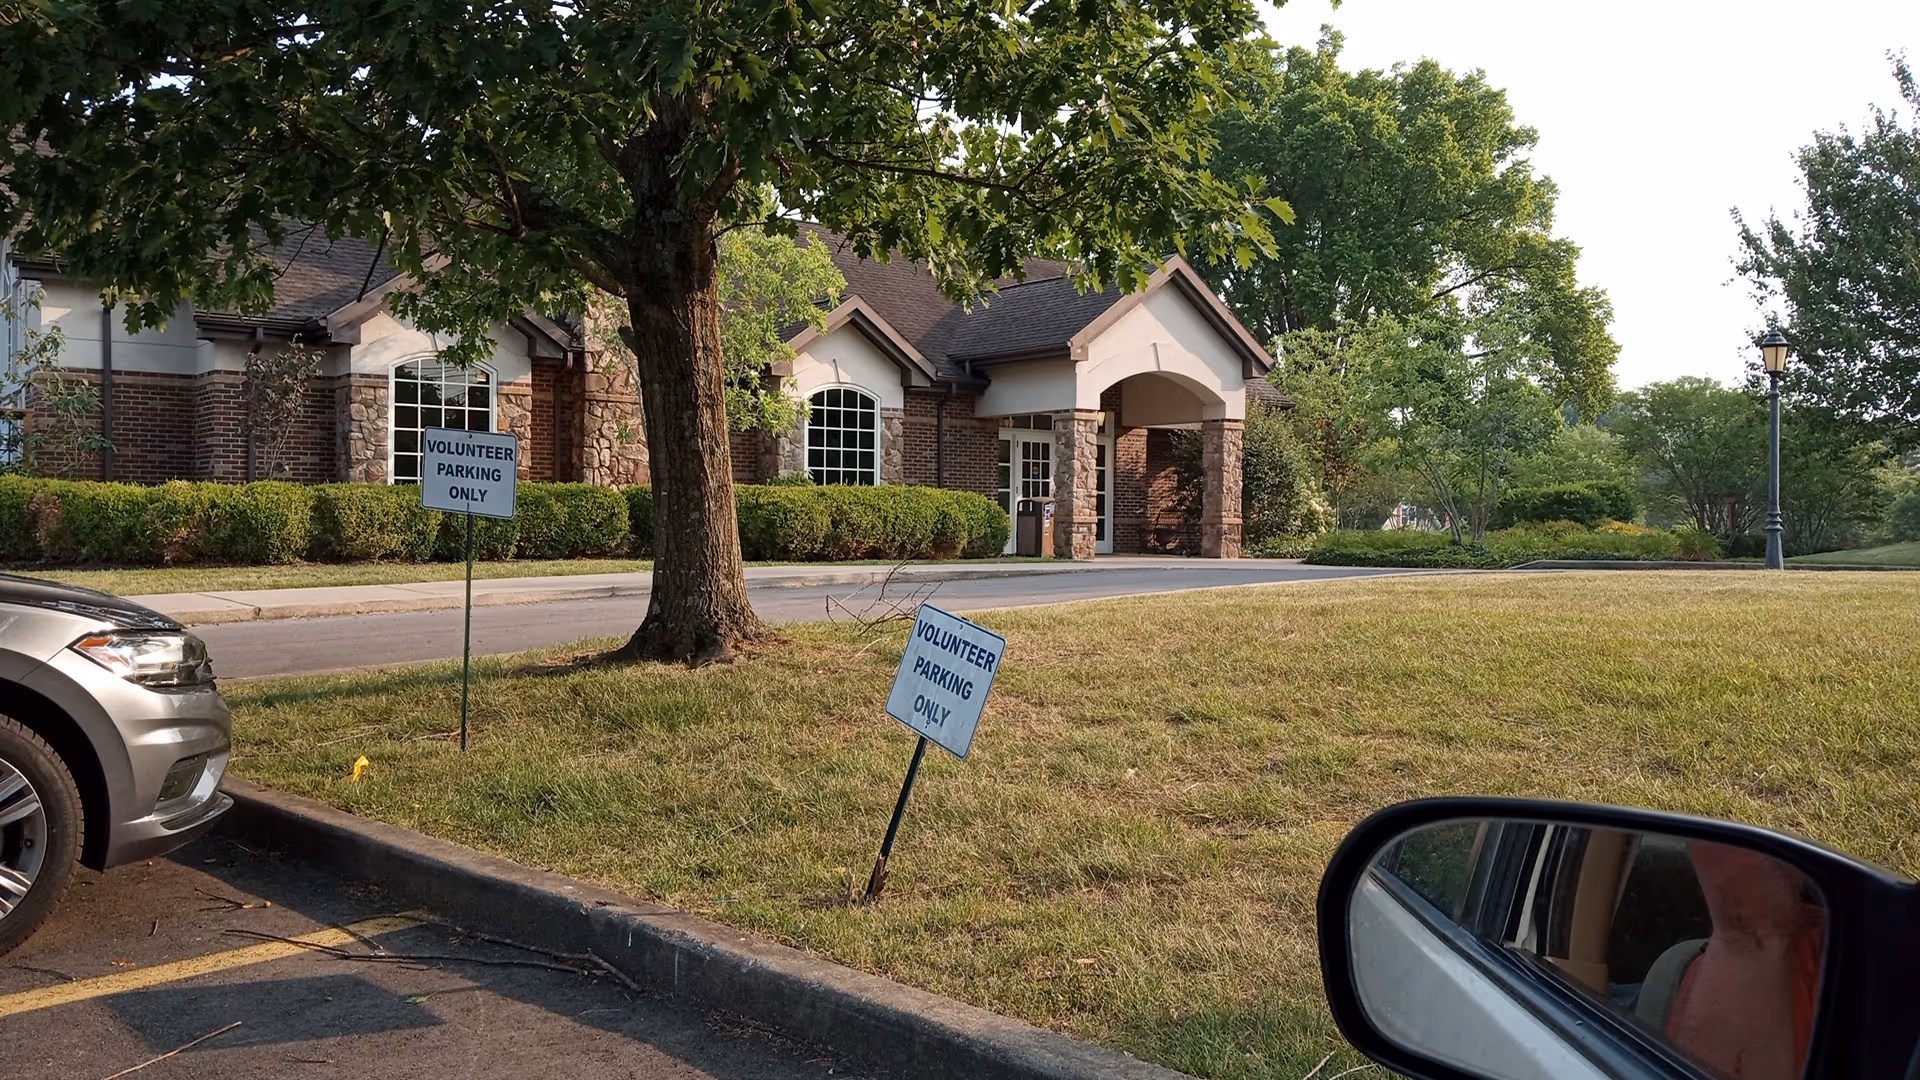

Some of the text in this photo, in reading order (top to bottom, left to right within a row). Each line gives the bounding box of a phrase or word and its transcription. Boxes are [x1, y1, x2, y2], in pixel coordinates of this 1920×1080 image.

[427, 440, 514, 461] VOLUNTEER
[437, 462, 502, 482] PARKING
[449, 486, 488, 502] ONLY
[917, 619, 996, 673] VOLUNTEER
[913, 655, 974, 701] PARKING
[913, 694, 952, 728] ONLY
